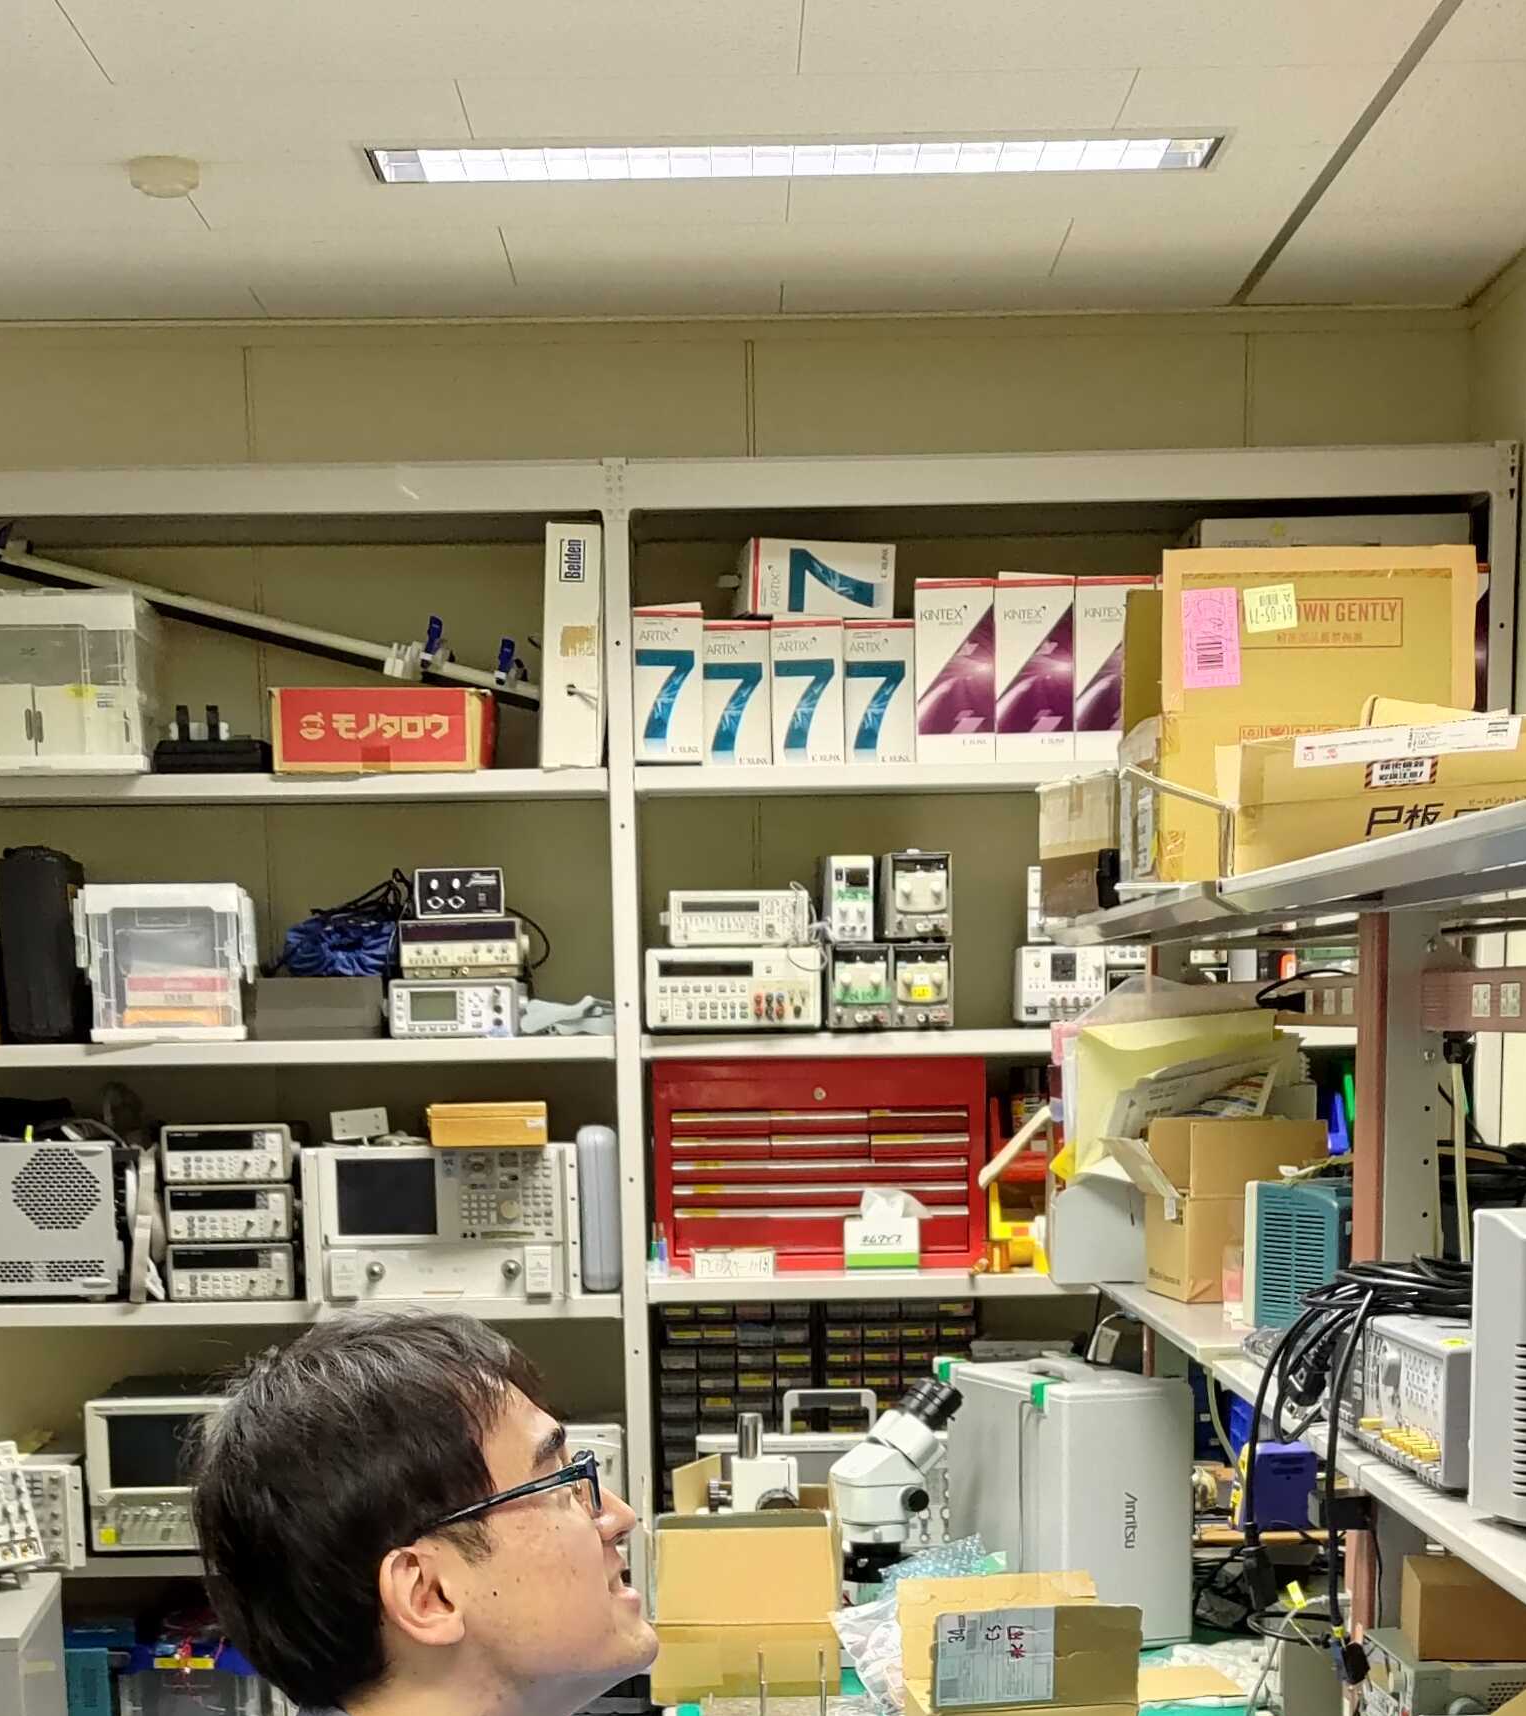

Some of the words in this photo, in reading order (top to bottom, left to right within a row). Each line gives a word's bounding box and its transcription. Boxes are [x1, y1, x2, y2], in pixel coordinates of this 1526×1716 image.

[564, 539, 582, 579] Belden
[770, 573, 779, 607] ARTIX
[788, 548, 874, 612] 7
[920, 607, 963, 620] KINTEX
[1003, 607, 1043, 620] KINTEX
[1084, 606, 1123, 619] KINTEX
[1336, 602, 1397, 622] GENTLY
[639, 631, 670, 641] ARTIX
[777, 641, 809, 652] ARTIX
[849, 641, 881, 652] ARTIX
[706, 644, 738, 656] ARTIX
[635, 649, 695, 739] 7
[703, 662, 763, 751] 7
[775, 658, 834, 749] 7
[846, 660, 906, 749] 7
[332, 713, 450, 740] モノタロウ
[1124, 1491, 1138, 1549] Anritsu
